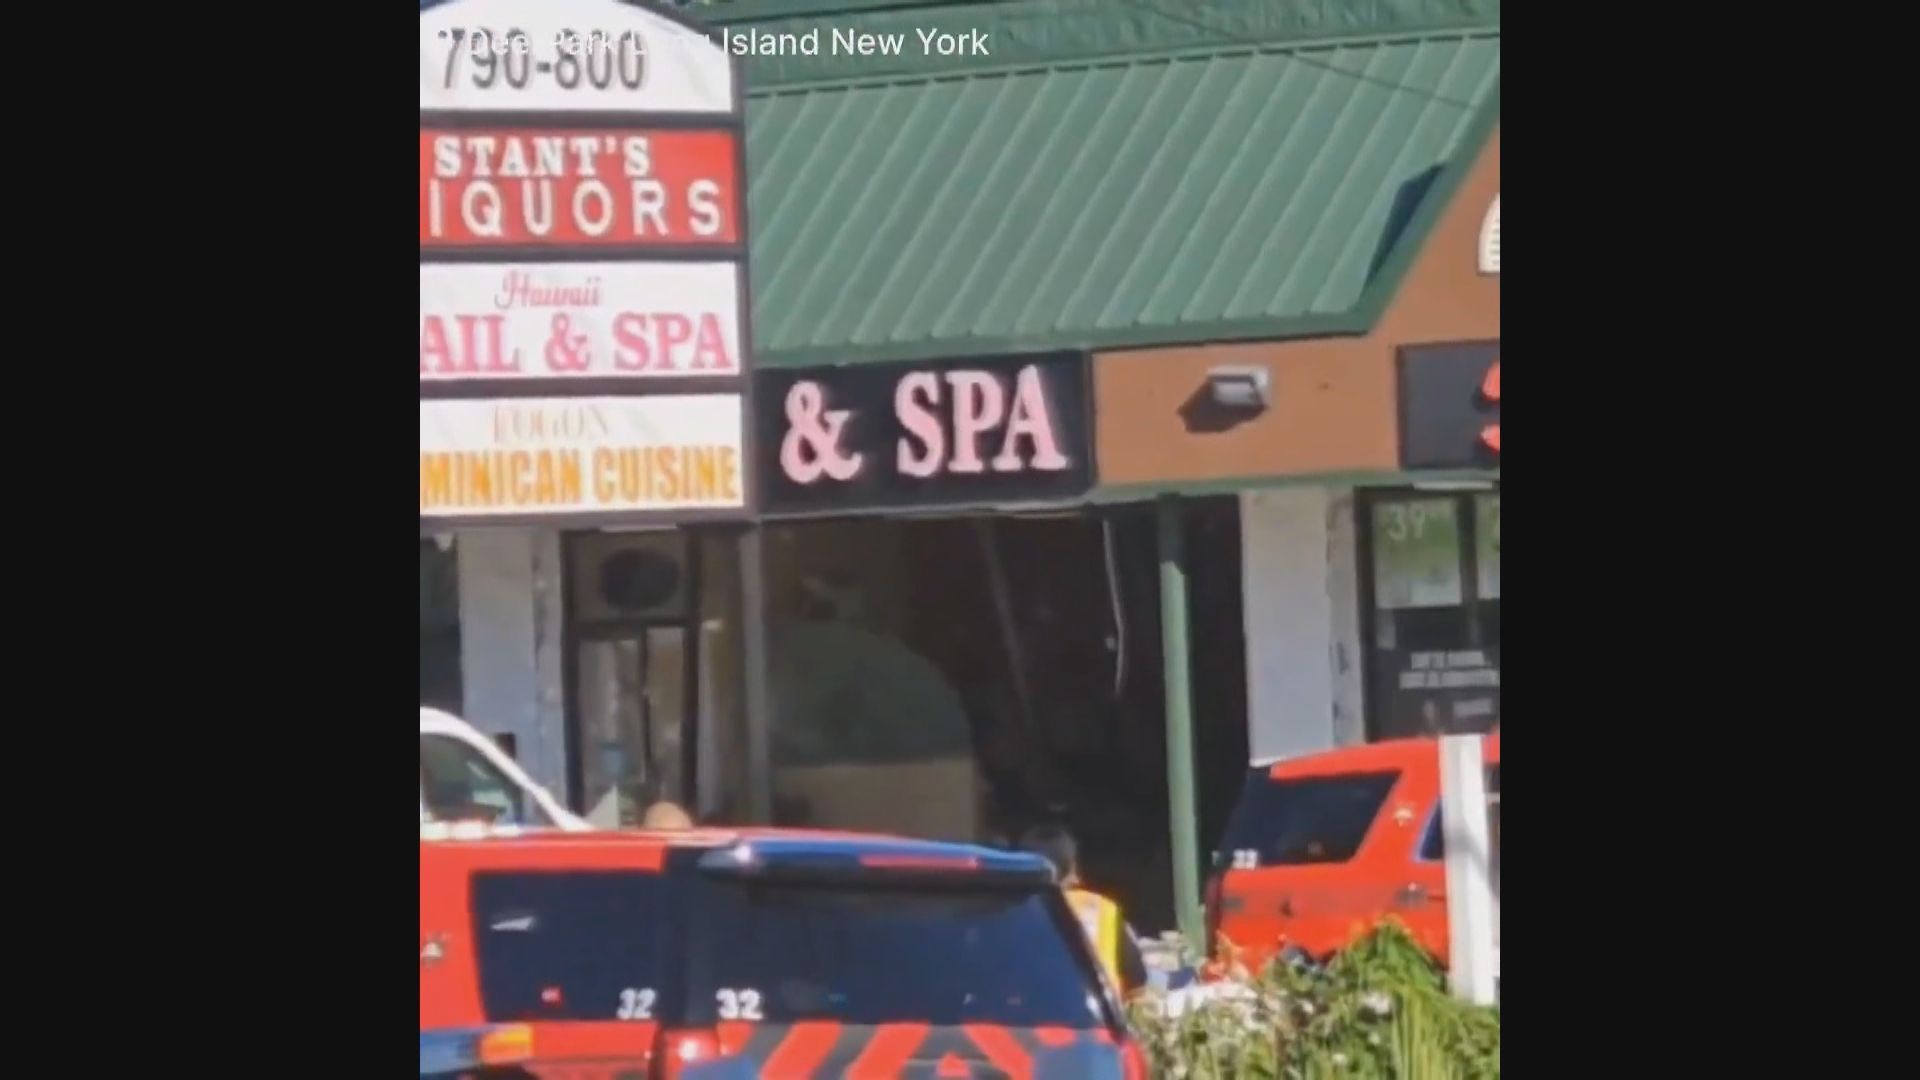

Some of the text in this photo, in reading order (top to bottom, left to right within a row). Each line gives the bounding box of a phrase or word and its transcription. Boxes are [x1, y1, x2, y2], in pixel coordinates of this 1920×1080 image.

[438, 27, 646, 91] 790-800
[433, 134, 651, 178] STANT'S
[544, 311, 592, 372] &
[612, 310, 732, 371] SPA
[780, 364, 1068, 483] & SPA
[593, 444, 738, 503] CUISINE
[617, 988, 657, 1020] 32
[715, 988, 764, 1020] 32
